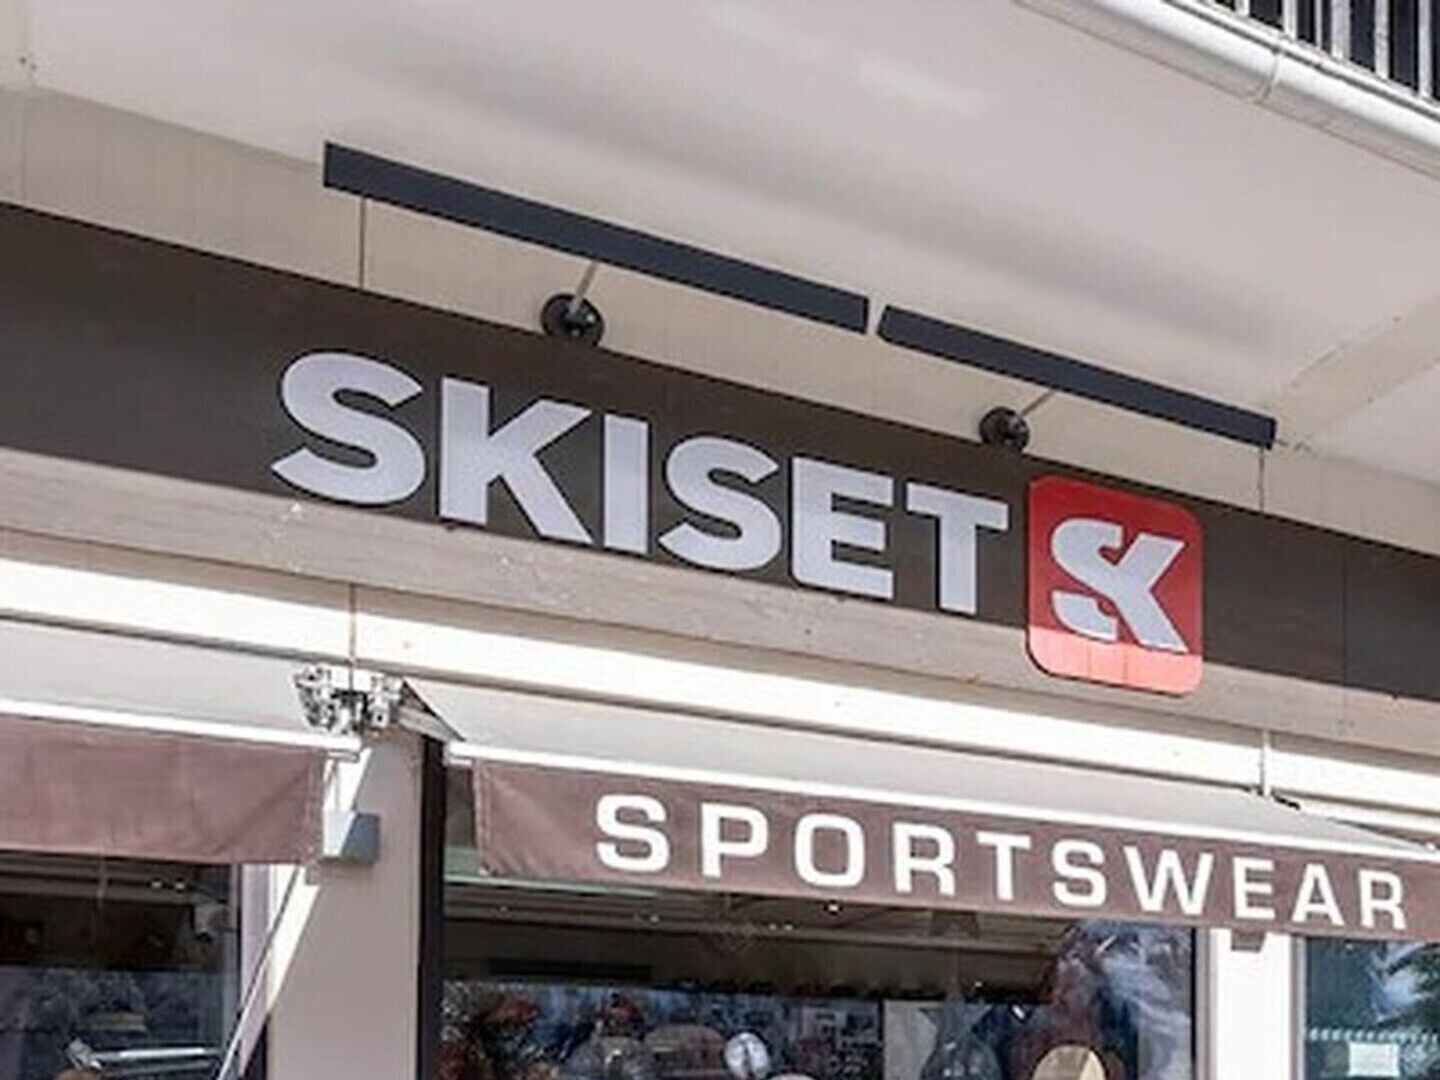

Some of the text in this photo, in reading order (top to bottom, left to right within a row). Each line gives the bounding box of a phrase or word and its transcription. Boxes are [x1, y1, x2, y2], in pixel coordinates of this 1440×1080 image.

[270, 351, 1009, 615] SKISET
[1051, 517, 1186, 653] SK
[596, 794, 1407, 930] SPORTSWEAR
